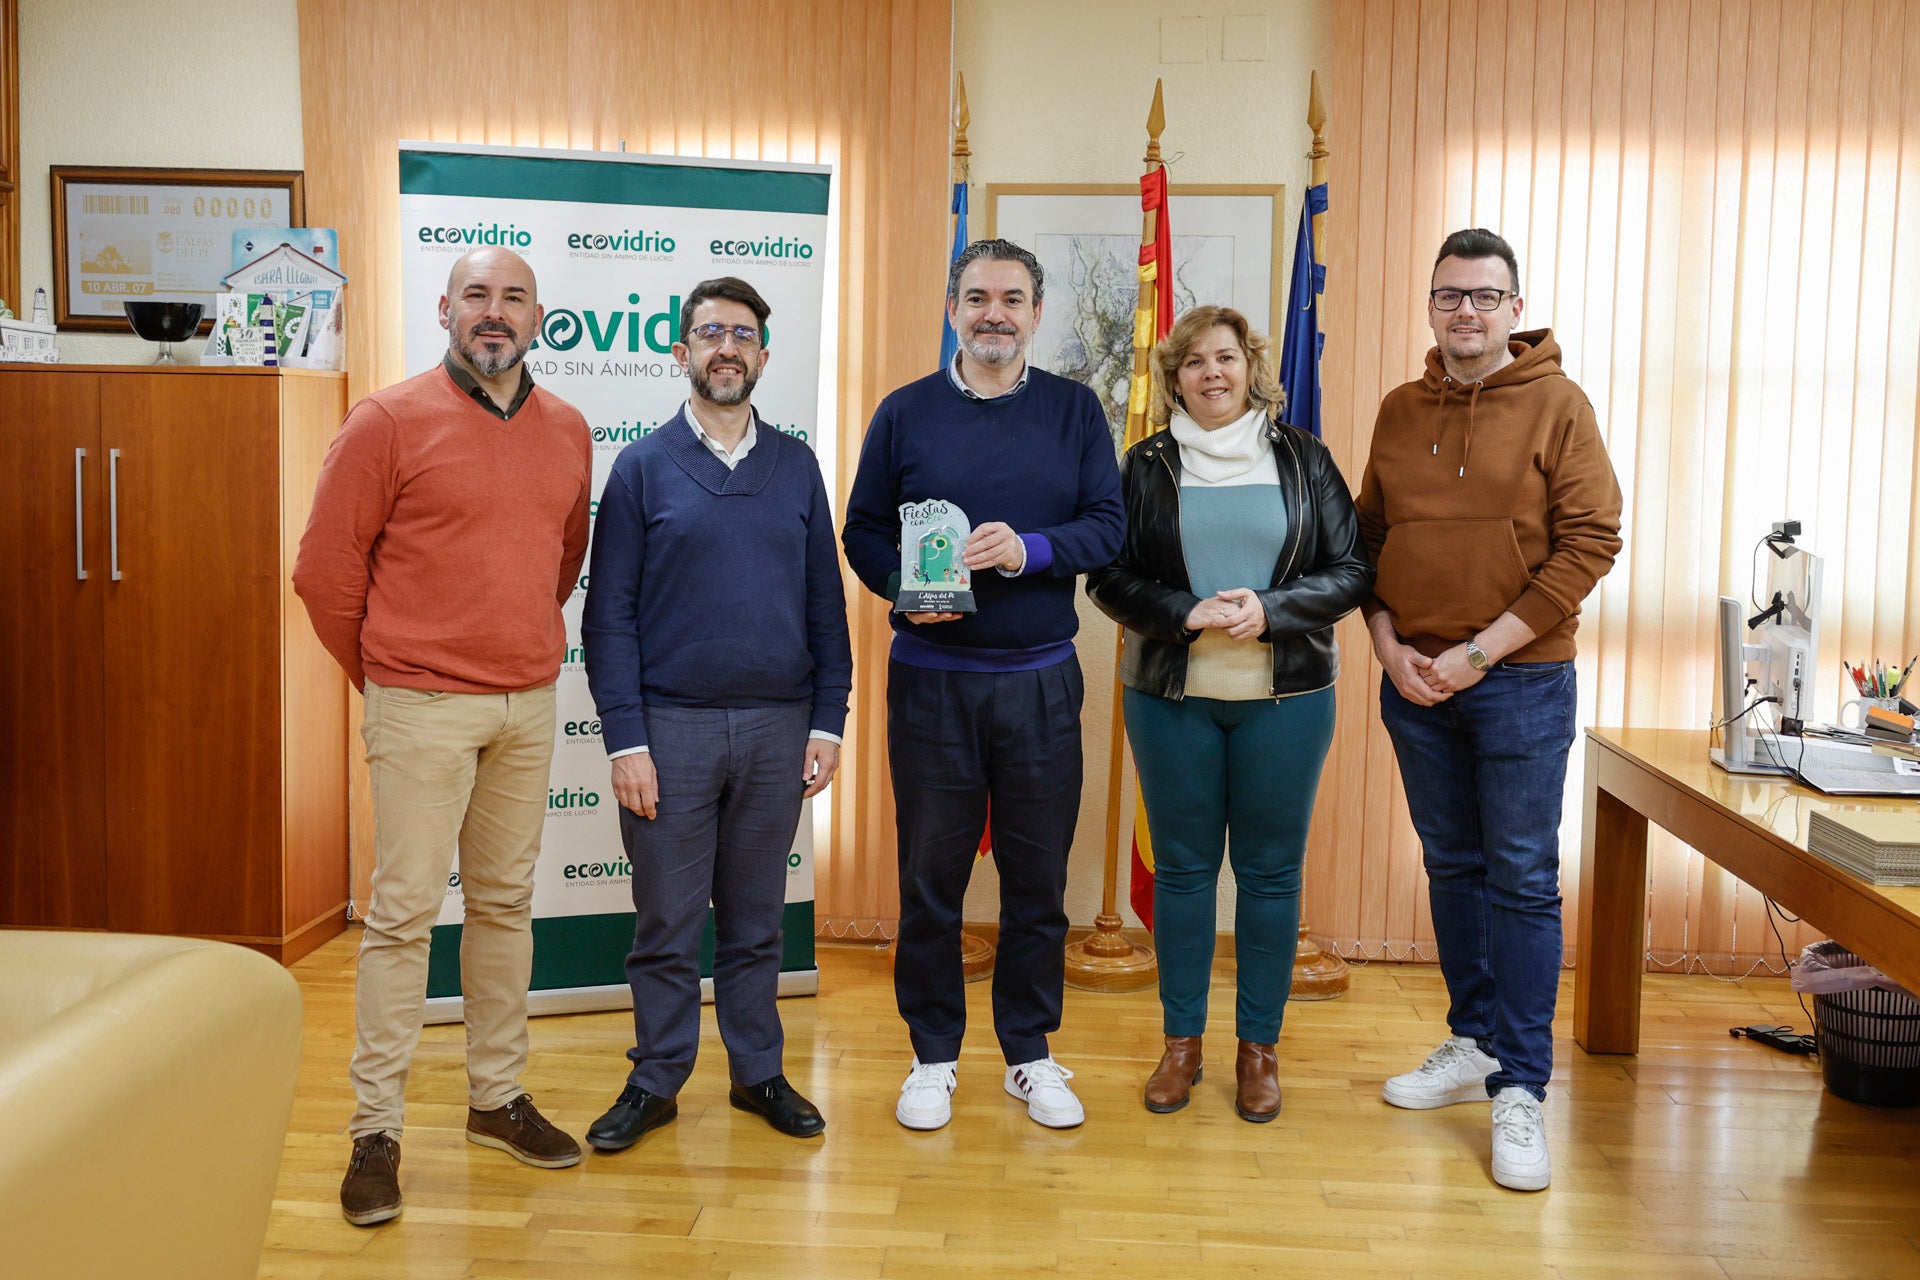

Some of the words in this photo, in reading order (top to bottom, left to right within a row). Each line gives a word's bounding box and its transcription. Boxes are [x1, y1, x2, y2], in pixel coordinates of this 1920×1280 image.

[418, 222, 532, 247] ecovidrio
[567, 229, 676, 253] ecovidrio
[420, 245, 452, 253] ENTIDAD
[454, 246, 467, 254] SIN
[569, 251, 599, 259] ENTIDAD
[601, 252, 613, 260] SIN
[638, 253, 648, 261] DE
[650, 254, 673, 262] LUCRO
[709, 235, 813, 259] ecovidrio
[711, 257, 741, 265] ENTIDAD
[742, 258, 754, 266] SIN
[778, 259, 788, 267] DE
[789, 260, 811, 268] LUCRO
[87, 281, 101, 292] 10
[103, 282, 130, 293] ABR.
[132, 282, 147, 294] 07
[564, 361, 594, 376] SIN
[600, 358, 664, 378] ÁNIMO
[902, 502, 948, 522] Fiestas
[548, 786, 600, 809] idrio
[545, 810, 562, 818] NIMO
